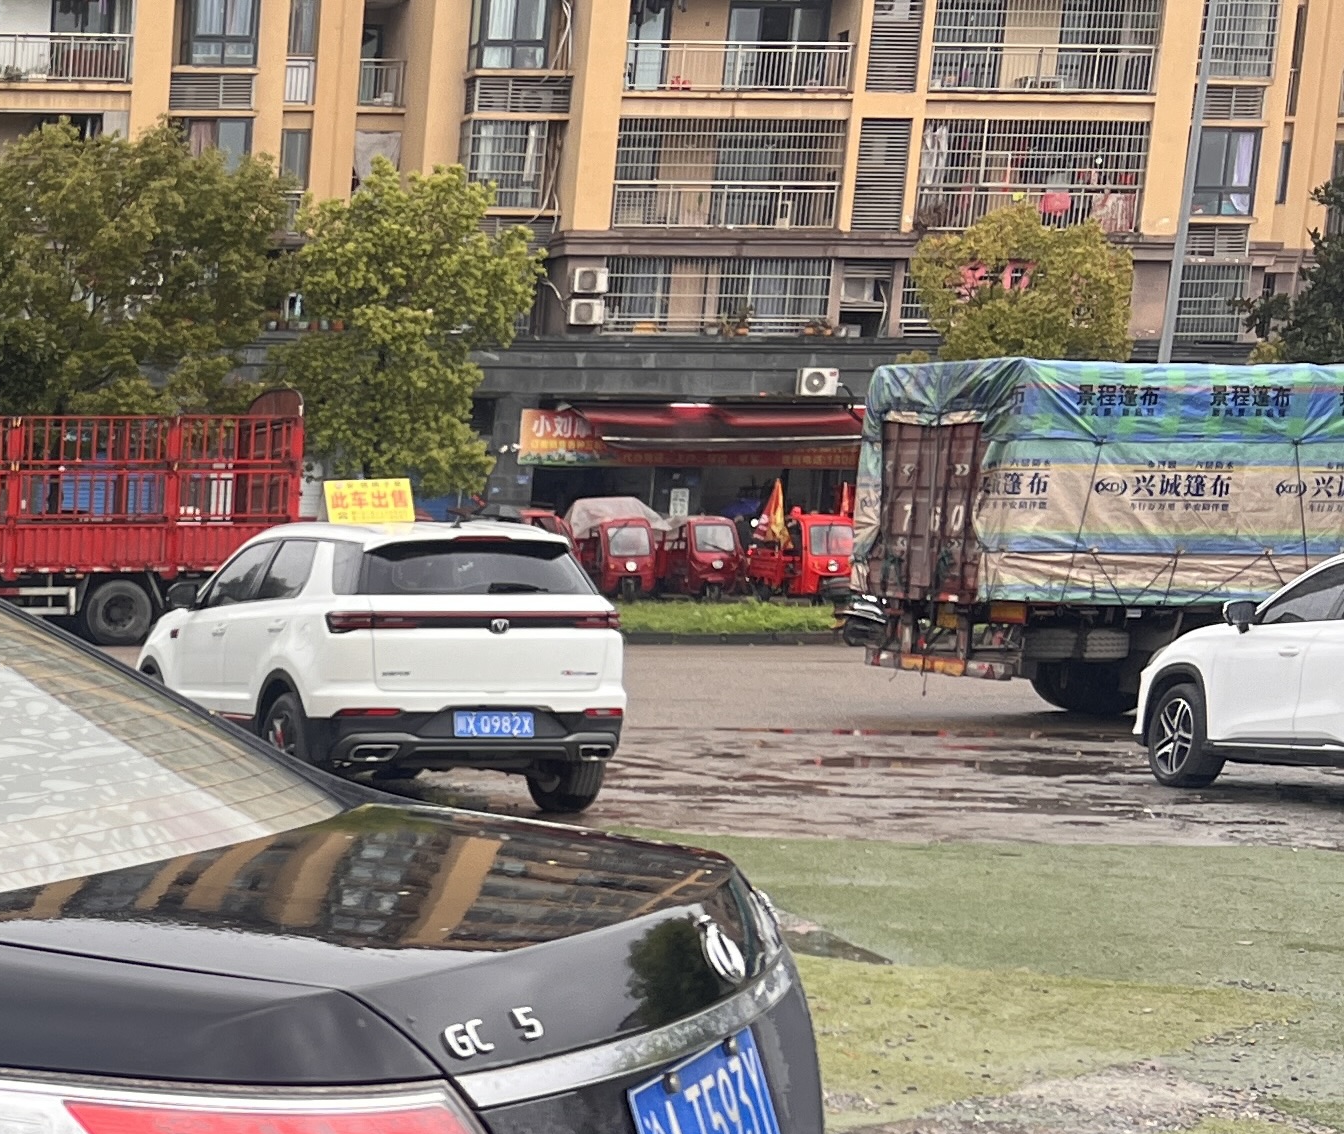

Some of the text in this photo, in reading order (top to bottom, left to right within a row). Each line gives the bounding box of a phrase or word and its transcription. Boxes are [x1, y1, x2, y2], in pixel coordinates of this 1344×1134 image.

[1133, 474, 1232, 497] 兴诚篷布
[442, 1006, 545, 1057] GC 5
